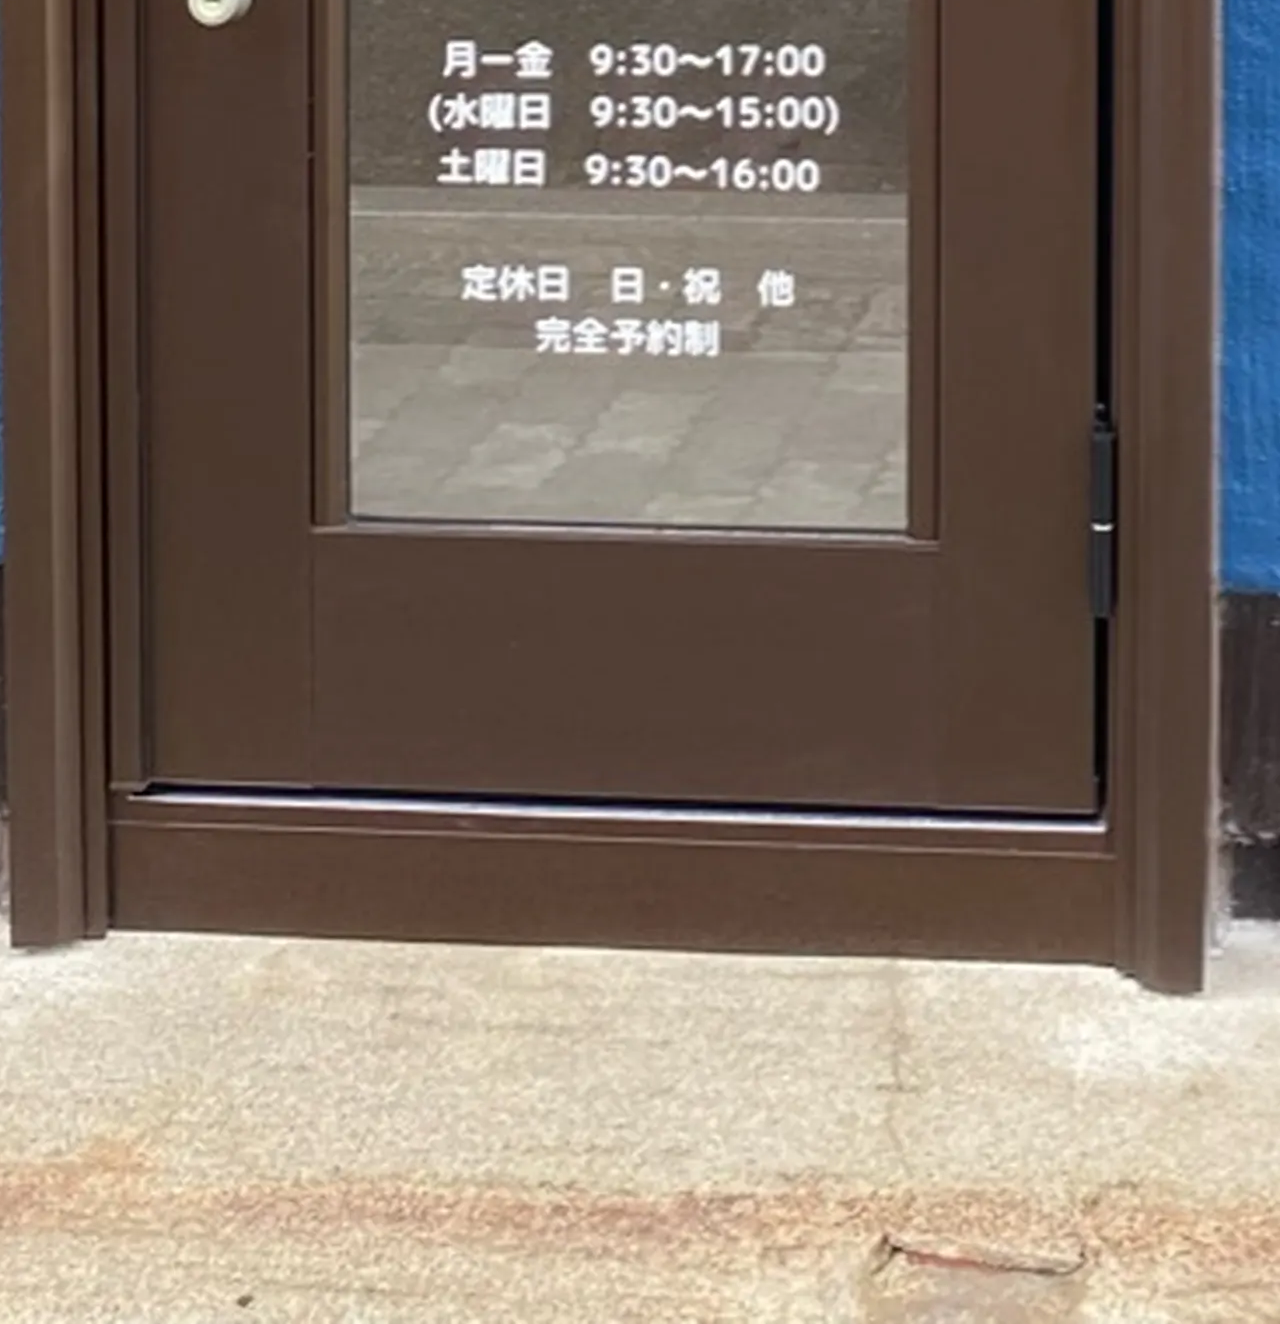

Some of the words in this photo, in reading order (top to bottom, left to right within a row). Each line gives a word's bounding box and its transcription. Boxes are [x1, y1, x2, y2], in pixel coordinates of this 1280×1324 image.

[428, 92, 551, 133] (水曜日
[436, 147, 547, 187] 土曜日
[460, 263, 570, 303] 定休日
[610, 266, 723, 306] 日・祝
[756, 268, 796, 308] 他
[534, 315, 721, 358] 完全予約制
